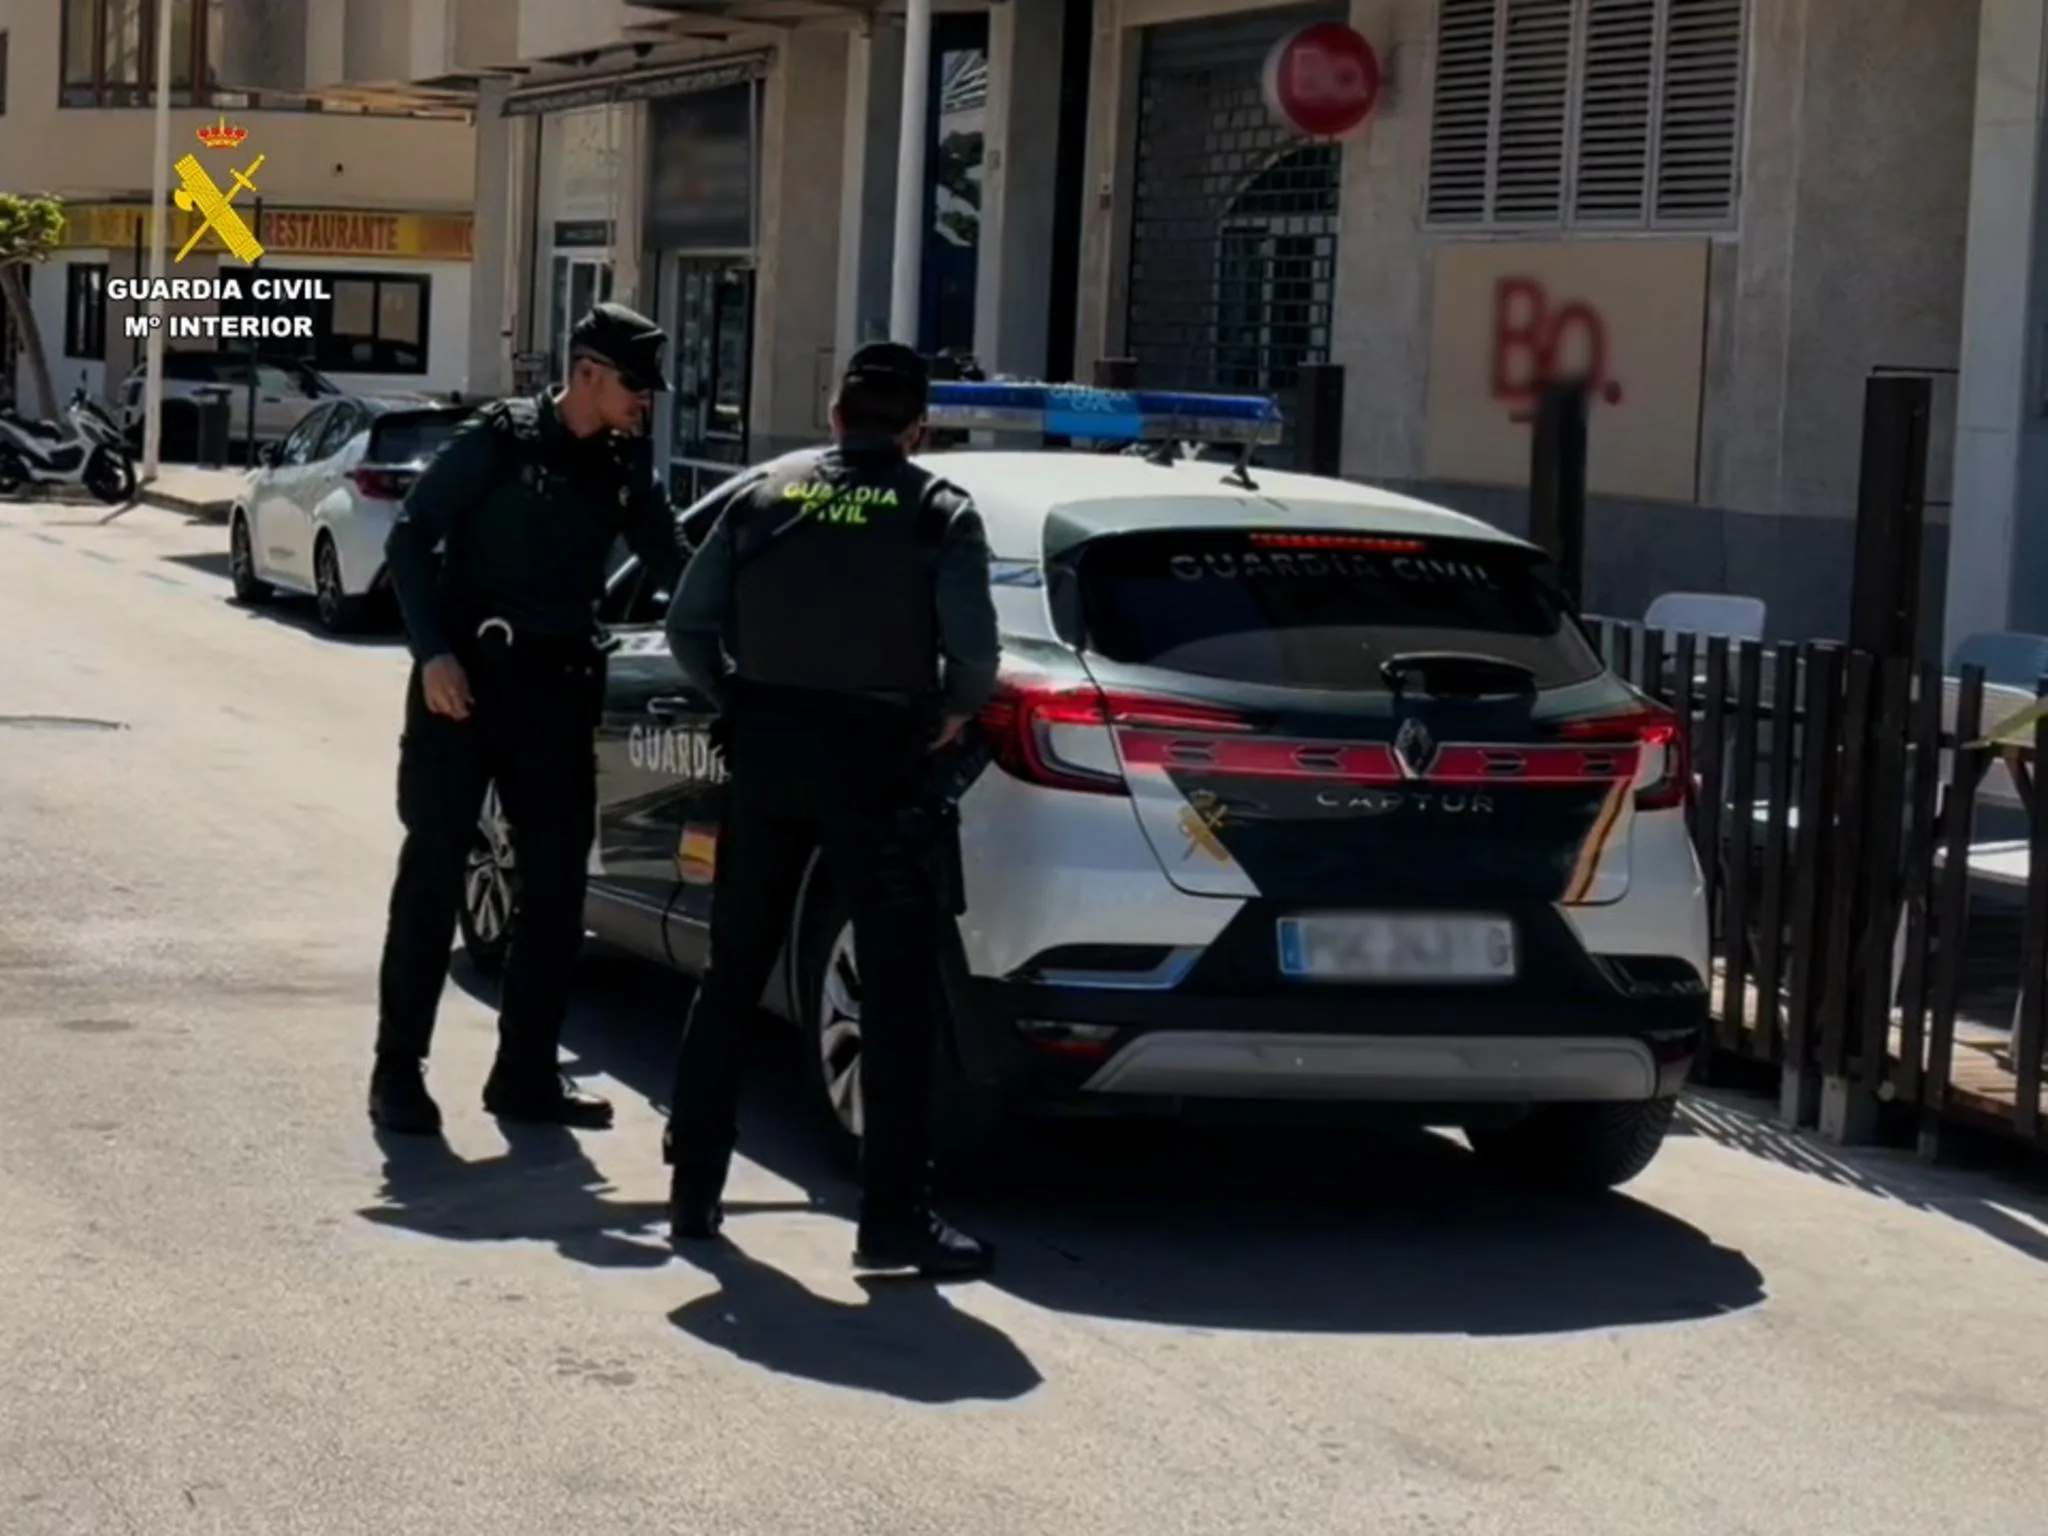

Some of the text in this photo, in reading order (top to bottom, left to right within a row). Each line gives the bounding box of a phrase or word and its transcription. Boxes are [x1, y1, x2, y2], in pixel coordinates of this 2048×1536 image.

[266, 212, 398, 250] RESTAURANTE
[1169, 553, 1383, 582] GUARDIA
[1316, 790, 1495, 814] CAPTUR
